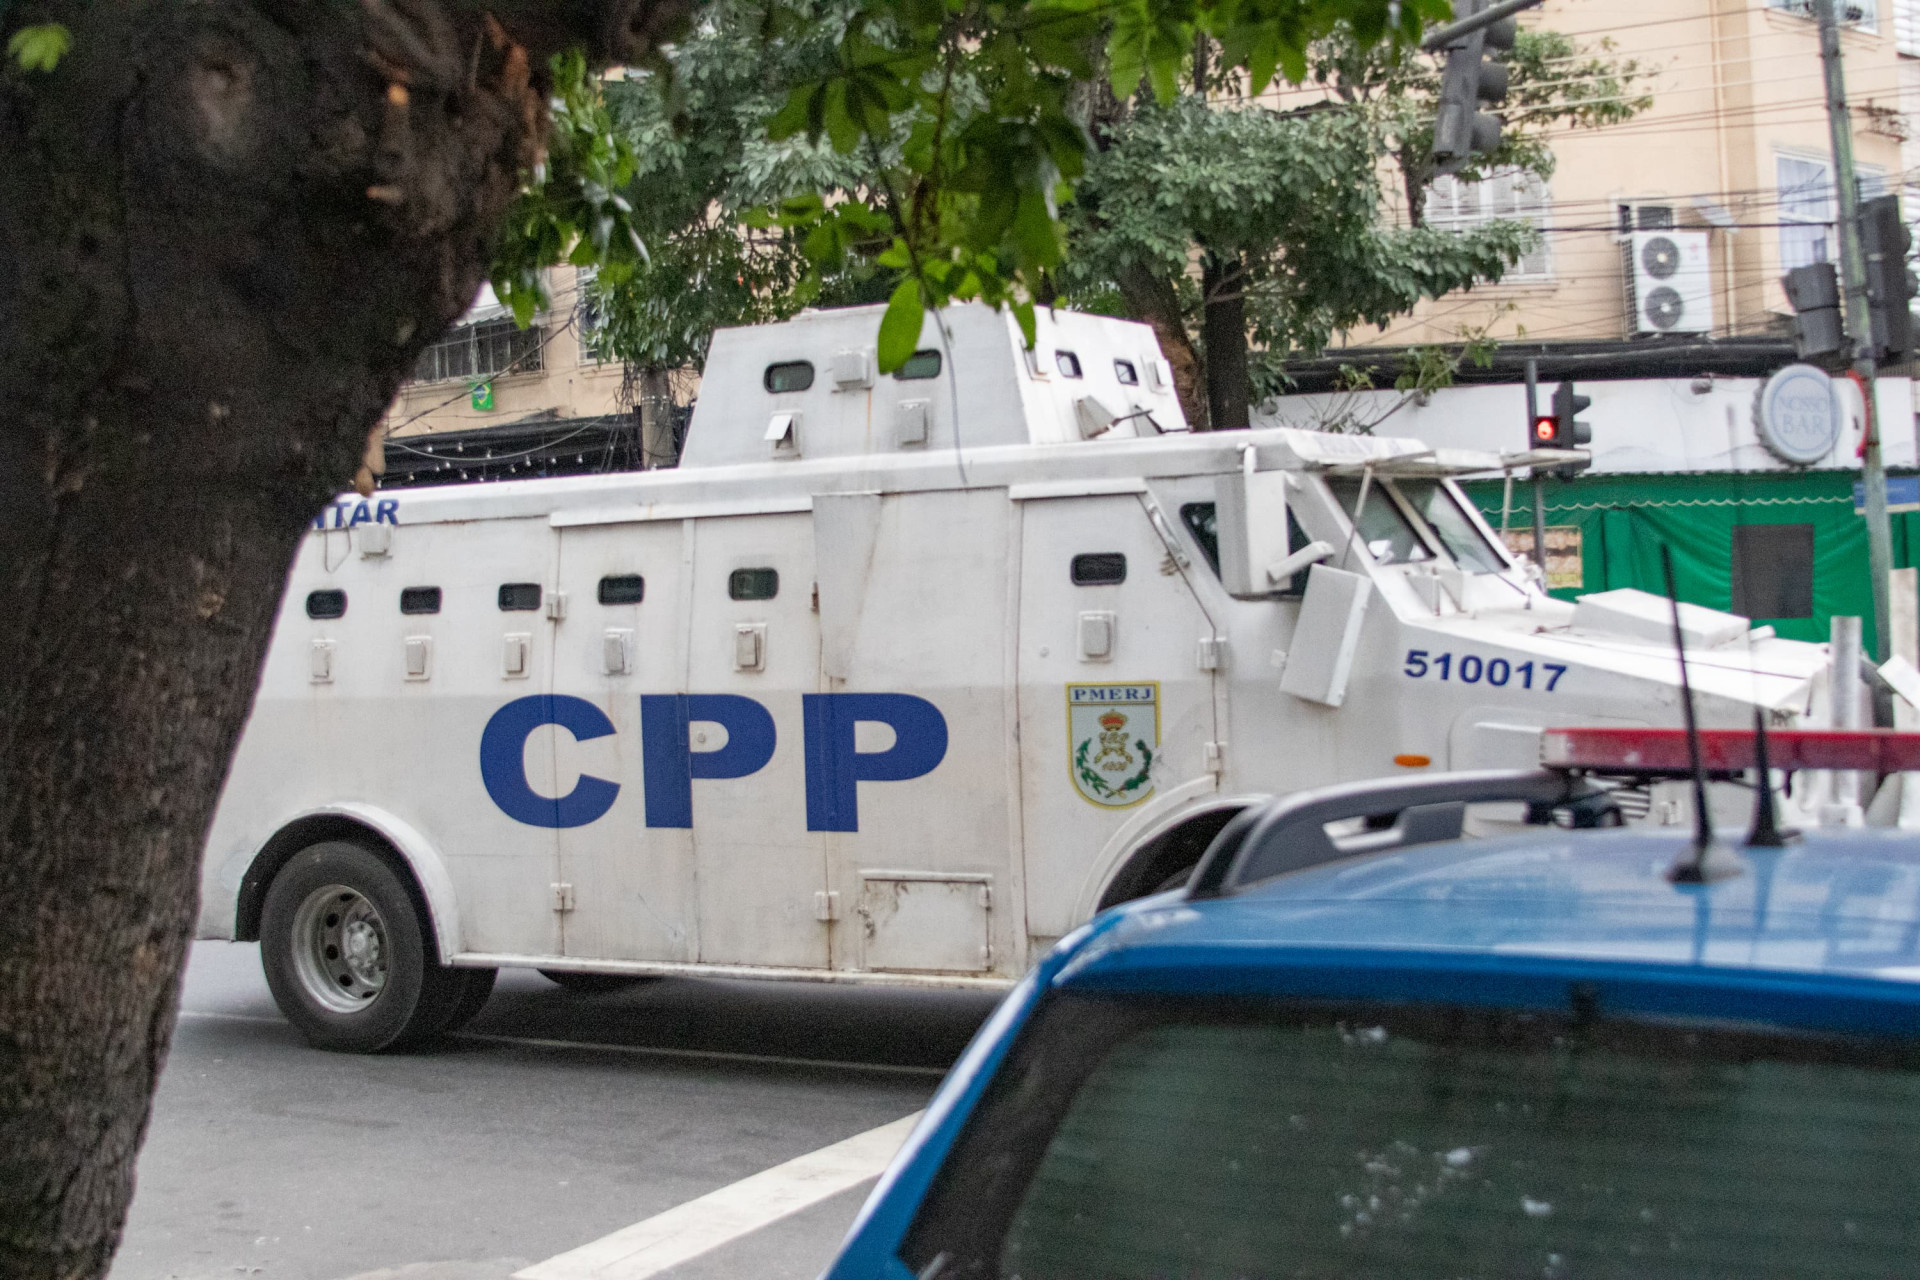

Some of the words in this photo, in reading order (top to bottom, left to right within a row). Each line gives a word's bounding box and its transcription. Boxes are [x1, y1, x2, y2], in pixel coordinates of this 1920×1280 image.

[1783, 413, 1826, 435] BAR
[1404, 649, 1567, 691] 510017
[1074, 688, 1151, 700] PMERJ
[480, 693, 948, 832] CPP
